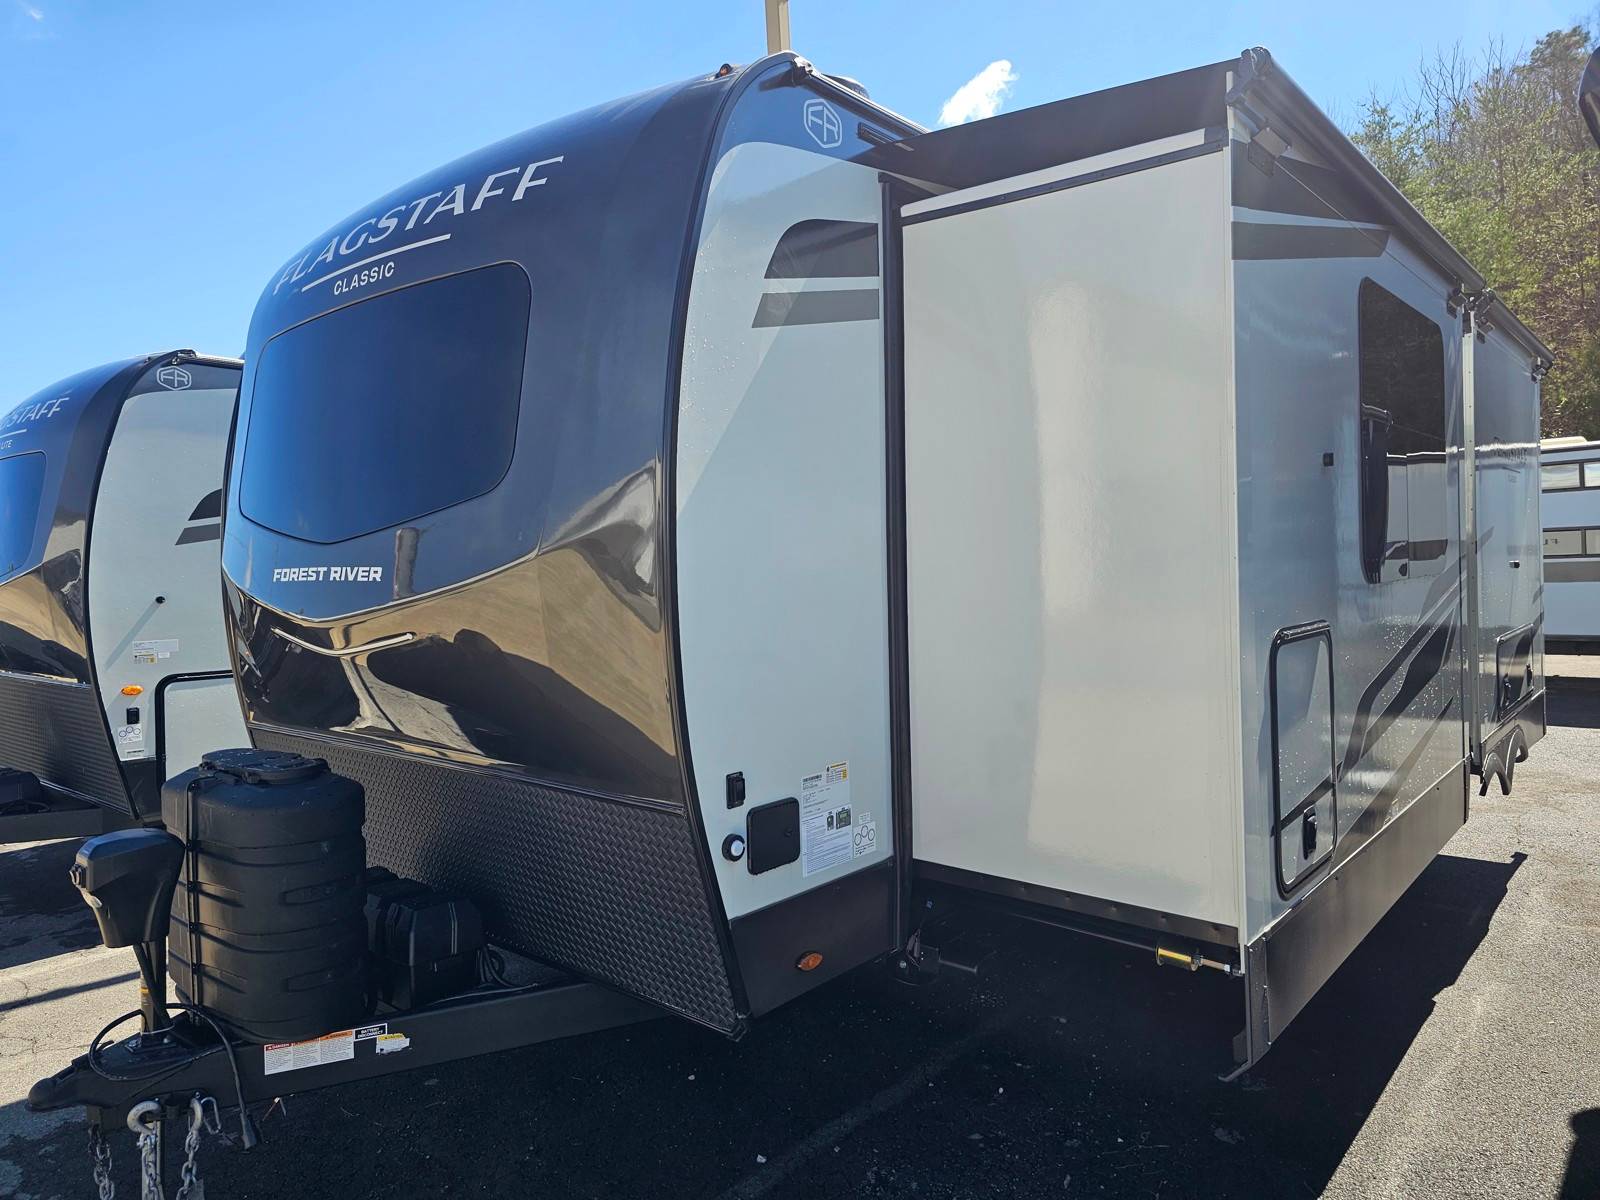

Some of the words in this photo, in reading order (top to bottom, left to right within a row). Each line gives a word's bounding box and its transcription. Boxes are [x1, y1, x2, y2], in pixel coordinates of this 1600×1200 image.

[272, 155, 564, 296] FLAGSTAFF
[333, 261, 395, 296] CLASSIC
[273, 567, 327, 582] FOREST
[329, 566, 383, 582] RIVER
[357, 1030, 384, 1039] DISCONNECT
[360, 1027, 380, 1035] BATTERY
